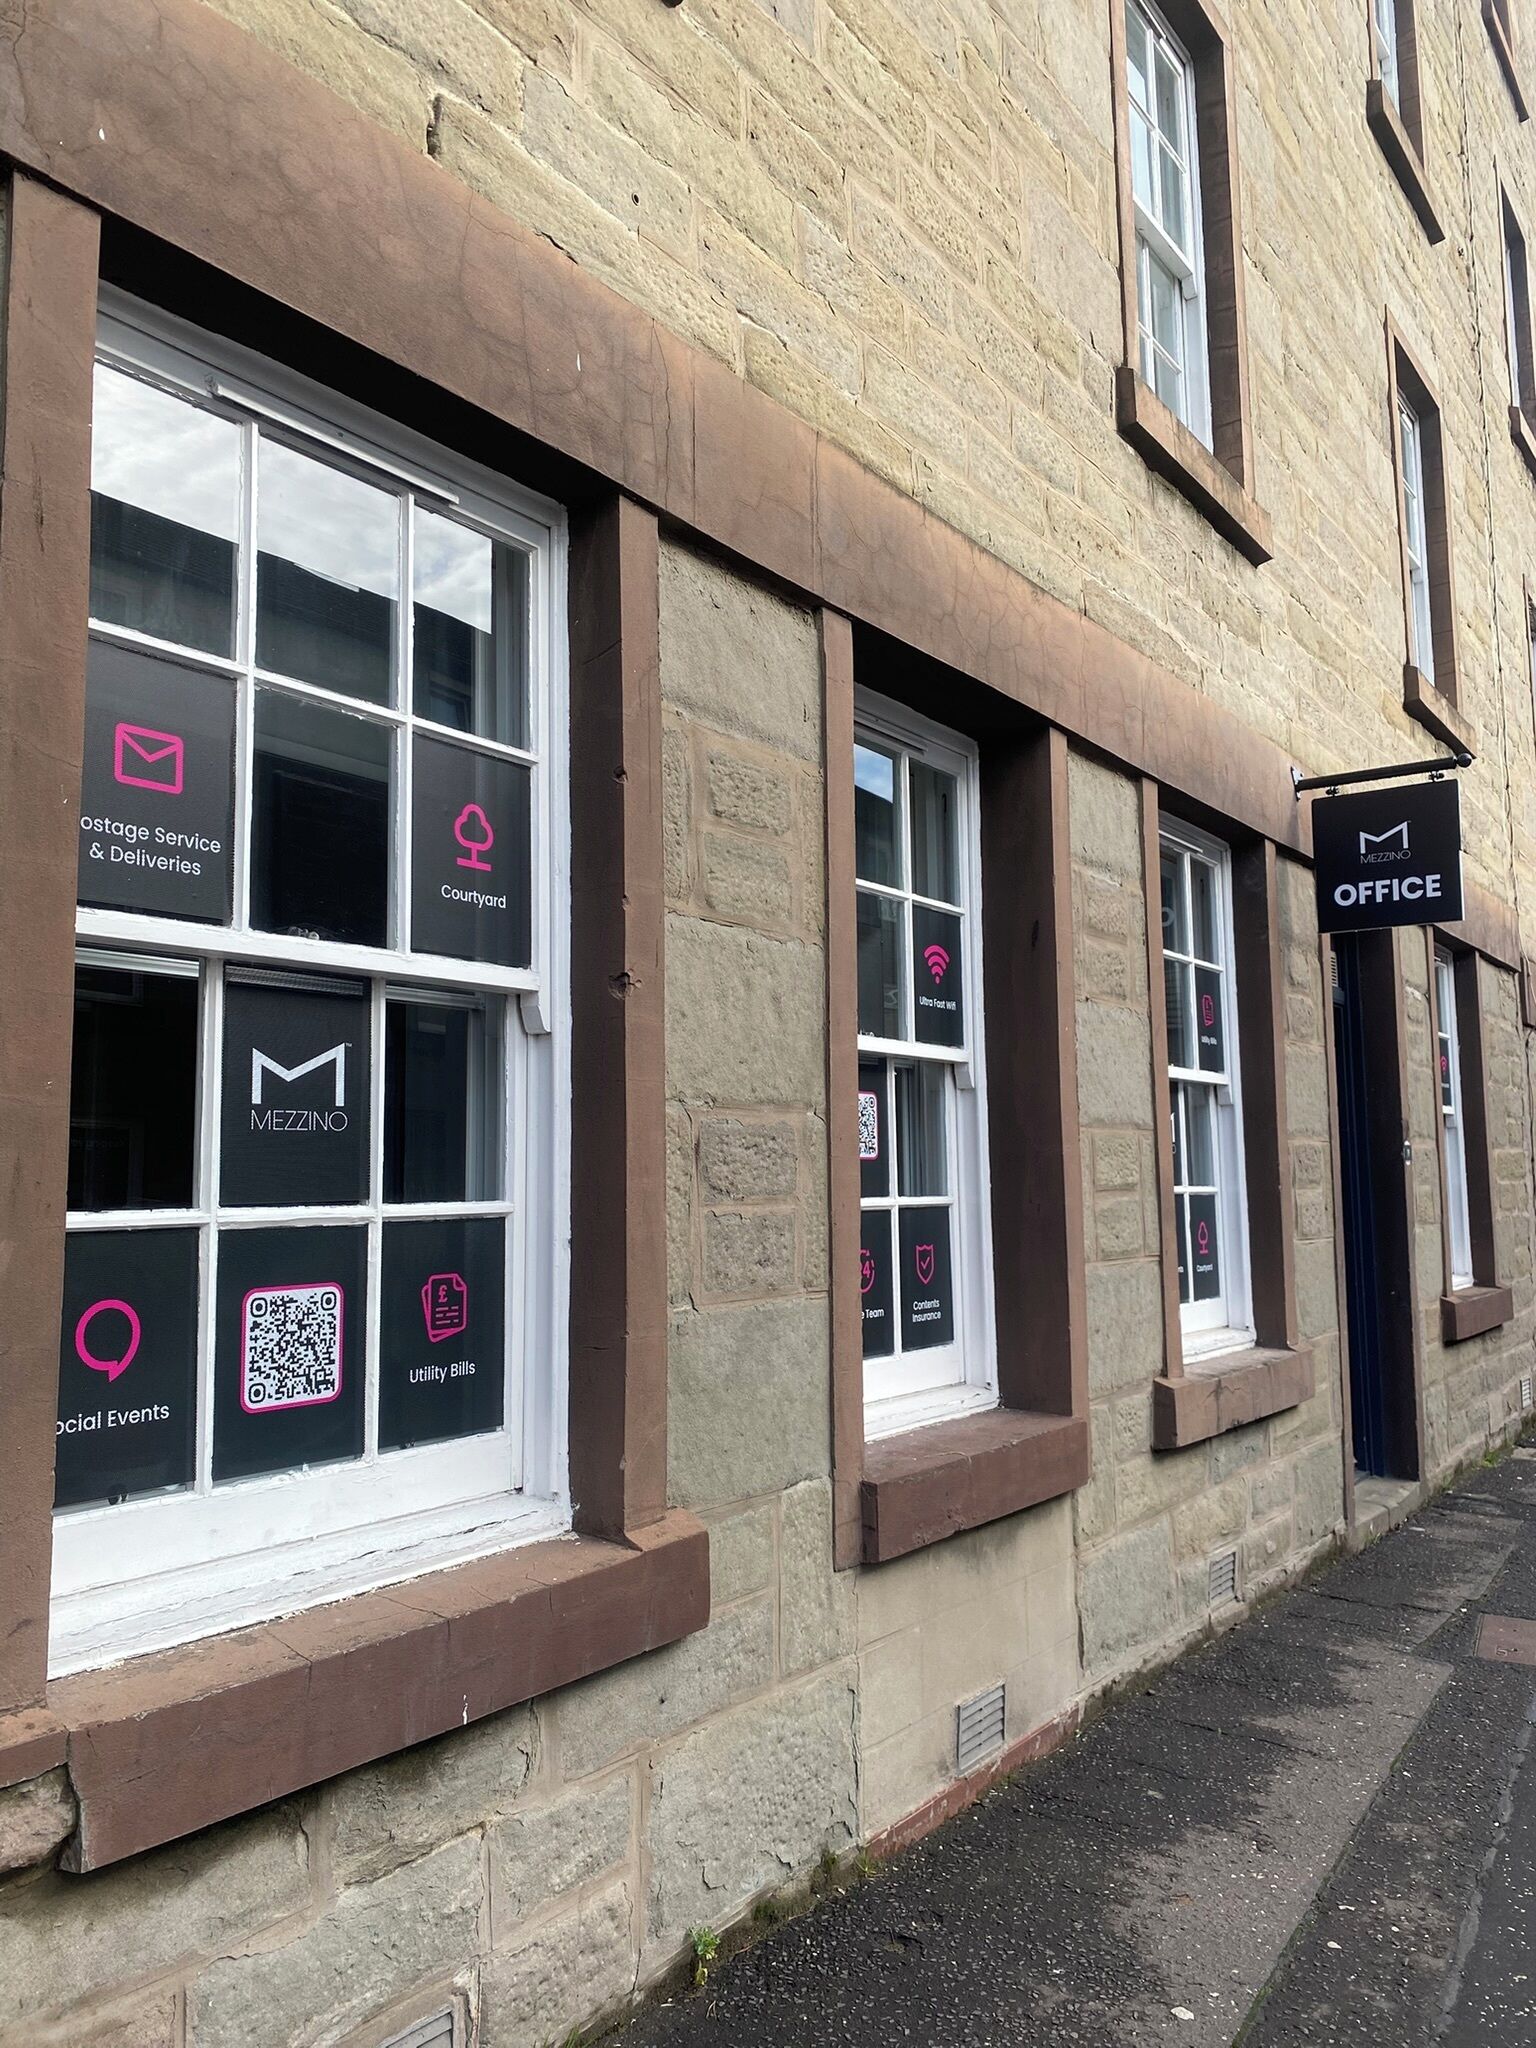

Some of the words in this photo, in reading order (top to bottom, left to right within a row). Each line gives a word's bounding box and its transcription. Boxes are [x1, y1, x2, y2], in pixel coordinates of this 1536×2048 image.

[80, 816, 150, 844] ostage
[154, 827, 222, 853] Service
[89, 842, 105, 860] &
[110, 846, 202, 876] Deliveries
[1360, 849, 1412, 864] MEZZINO
[441, 884, 506, 909] Courtyard
[1333, 873, 1442, 907] OFFICE
[933, 998, 945, 1009] Fast
[250, 1109, 348, 1132] MEZZINO
[865, 1308, 885, 1319] Team
[912, 1298, 940, 1311] Contents
[912, 1311, 942, 1323] Insurance
[409, 1364, 448, 1384] Utility
[450, 1360, 476, 1377] Bills
[55, 1411, 102, 1436] ocial
[107, 1404, 170, 1428] Events
